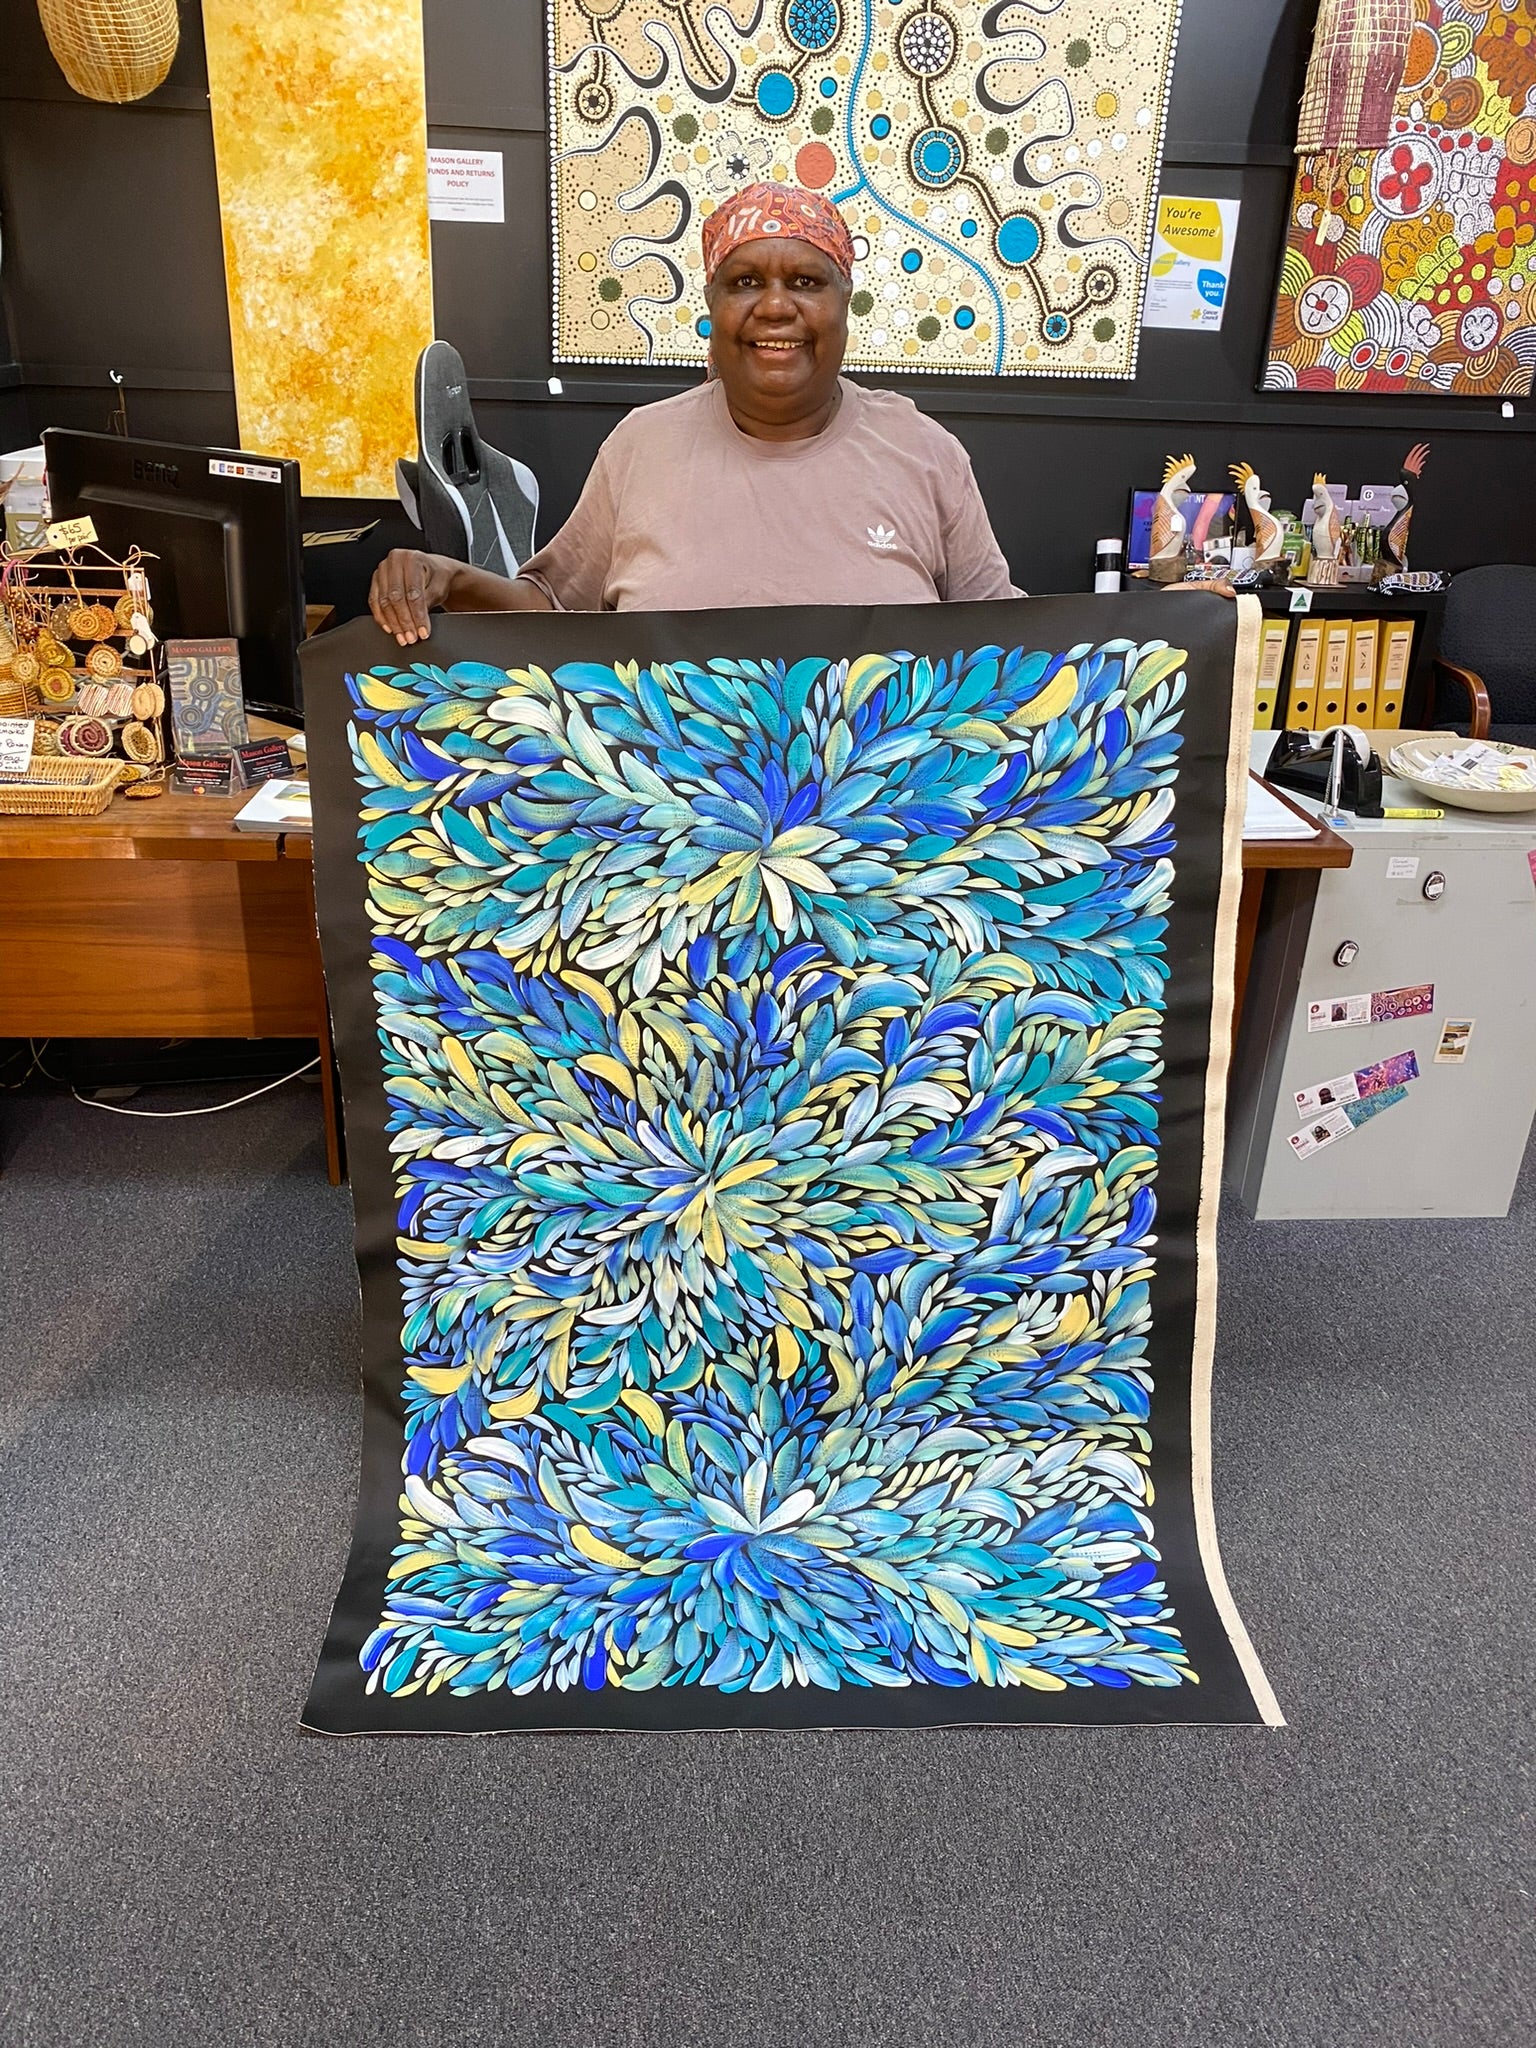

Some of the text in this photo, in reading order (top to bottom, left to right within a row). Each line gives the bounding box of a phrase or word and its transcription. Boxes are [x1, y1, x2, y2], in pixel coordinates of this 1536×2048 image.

[430, 156, 484, 165] MASON GALLERY
[1166, 207, 1202, 220] You're
[1202, 281, 1225, 289] Thank
[263, 744, 286, 754] Gallery
[202, 760, 229, 769] Gallery
